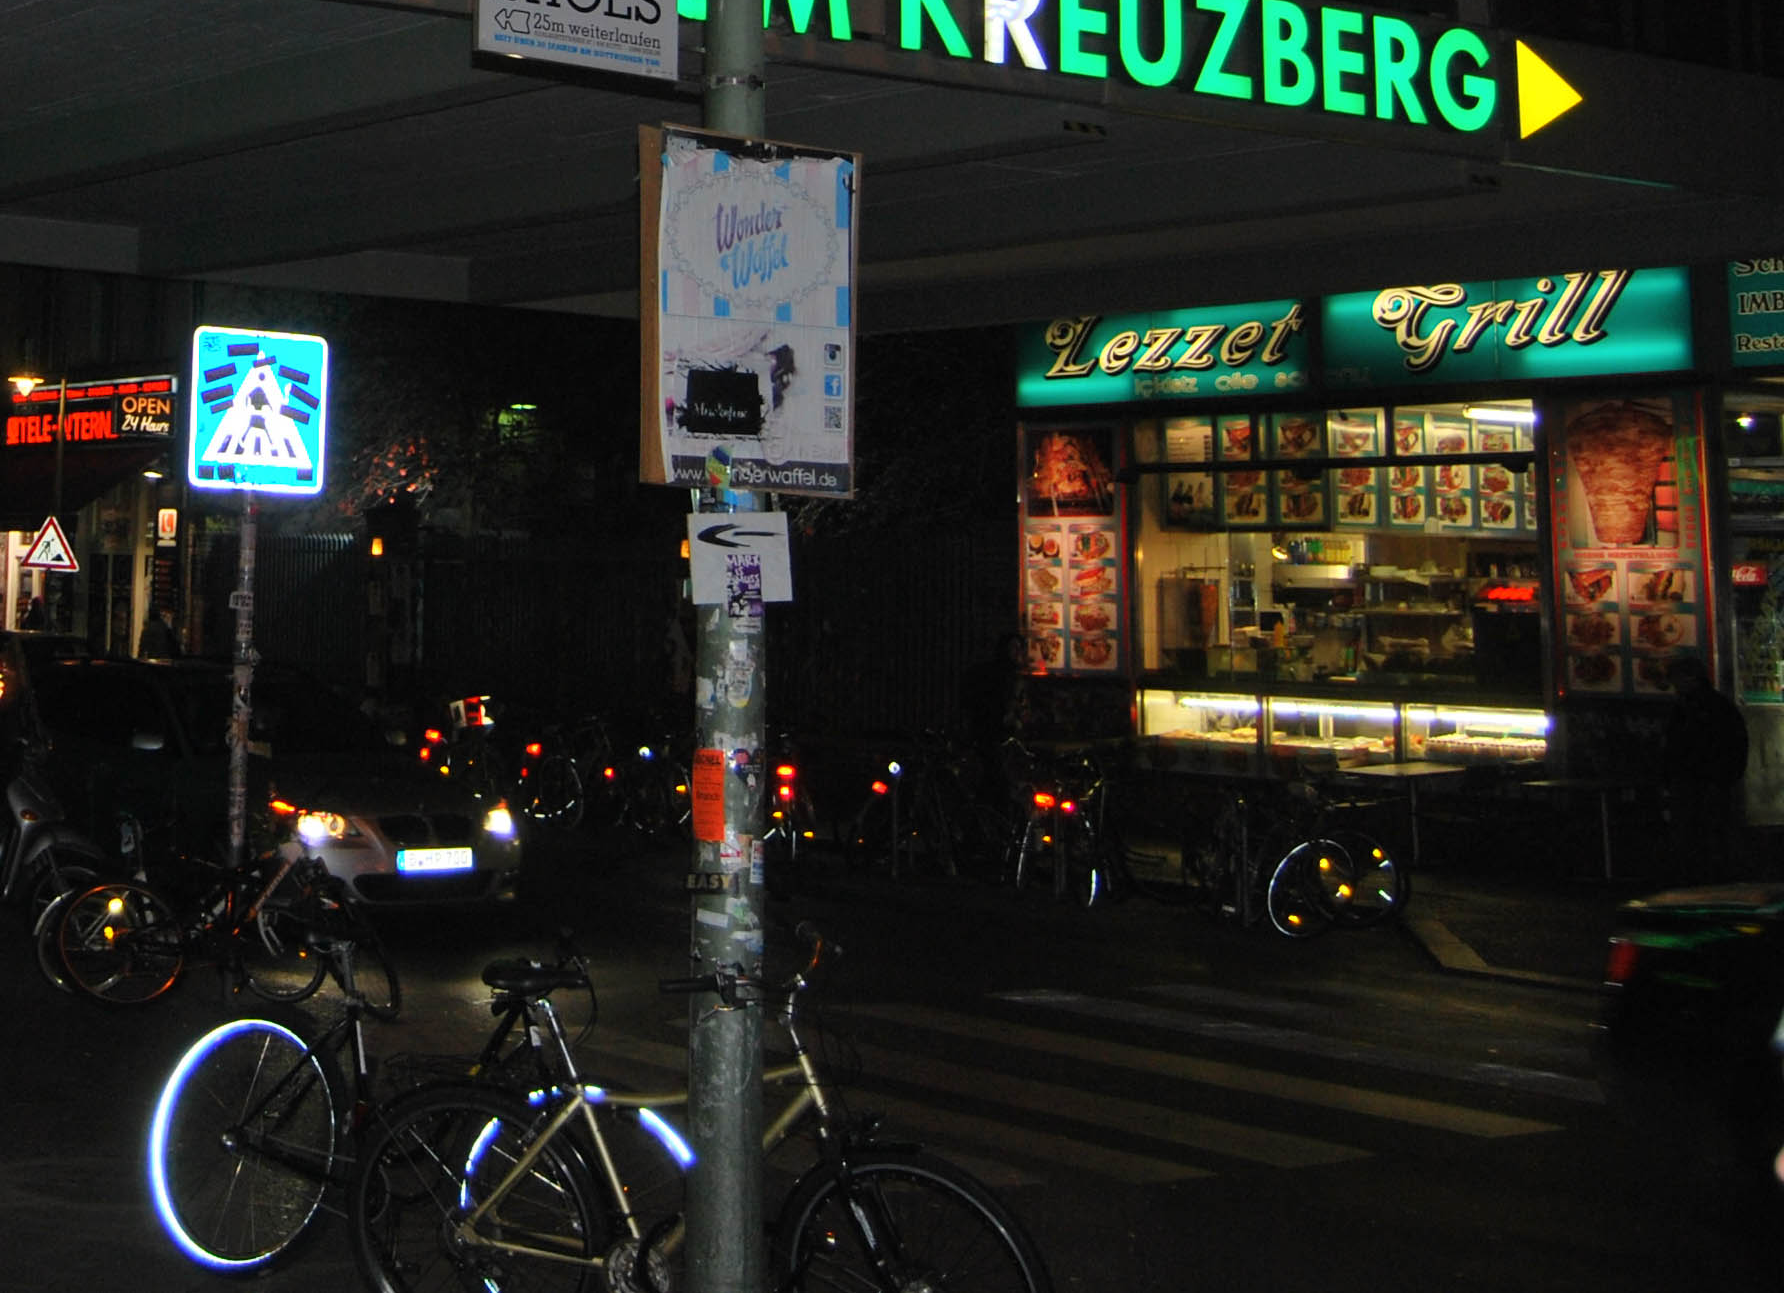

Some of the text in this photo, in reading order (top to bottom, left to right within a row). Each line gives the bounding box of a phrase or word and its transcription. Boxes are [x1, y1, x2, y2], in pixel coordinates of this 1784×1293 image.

[533, 13, 566, 35] 25m
[568, 20, 662, 50] weiterlaufen
[716, 202, 784, 254] Wonder
[720, 234, 789, 290] Waffel
[1044, 302, 1304, 379] Lezzet
[1372, 268, 1634, 371] Grill
[120, 414, 138, 433] 24
[121, 397, 171, 415] OPEN
[671, 460, 838, 488] www.nderwaffel.de
